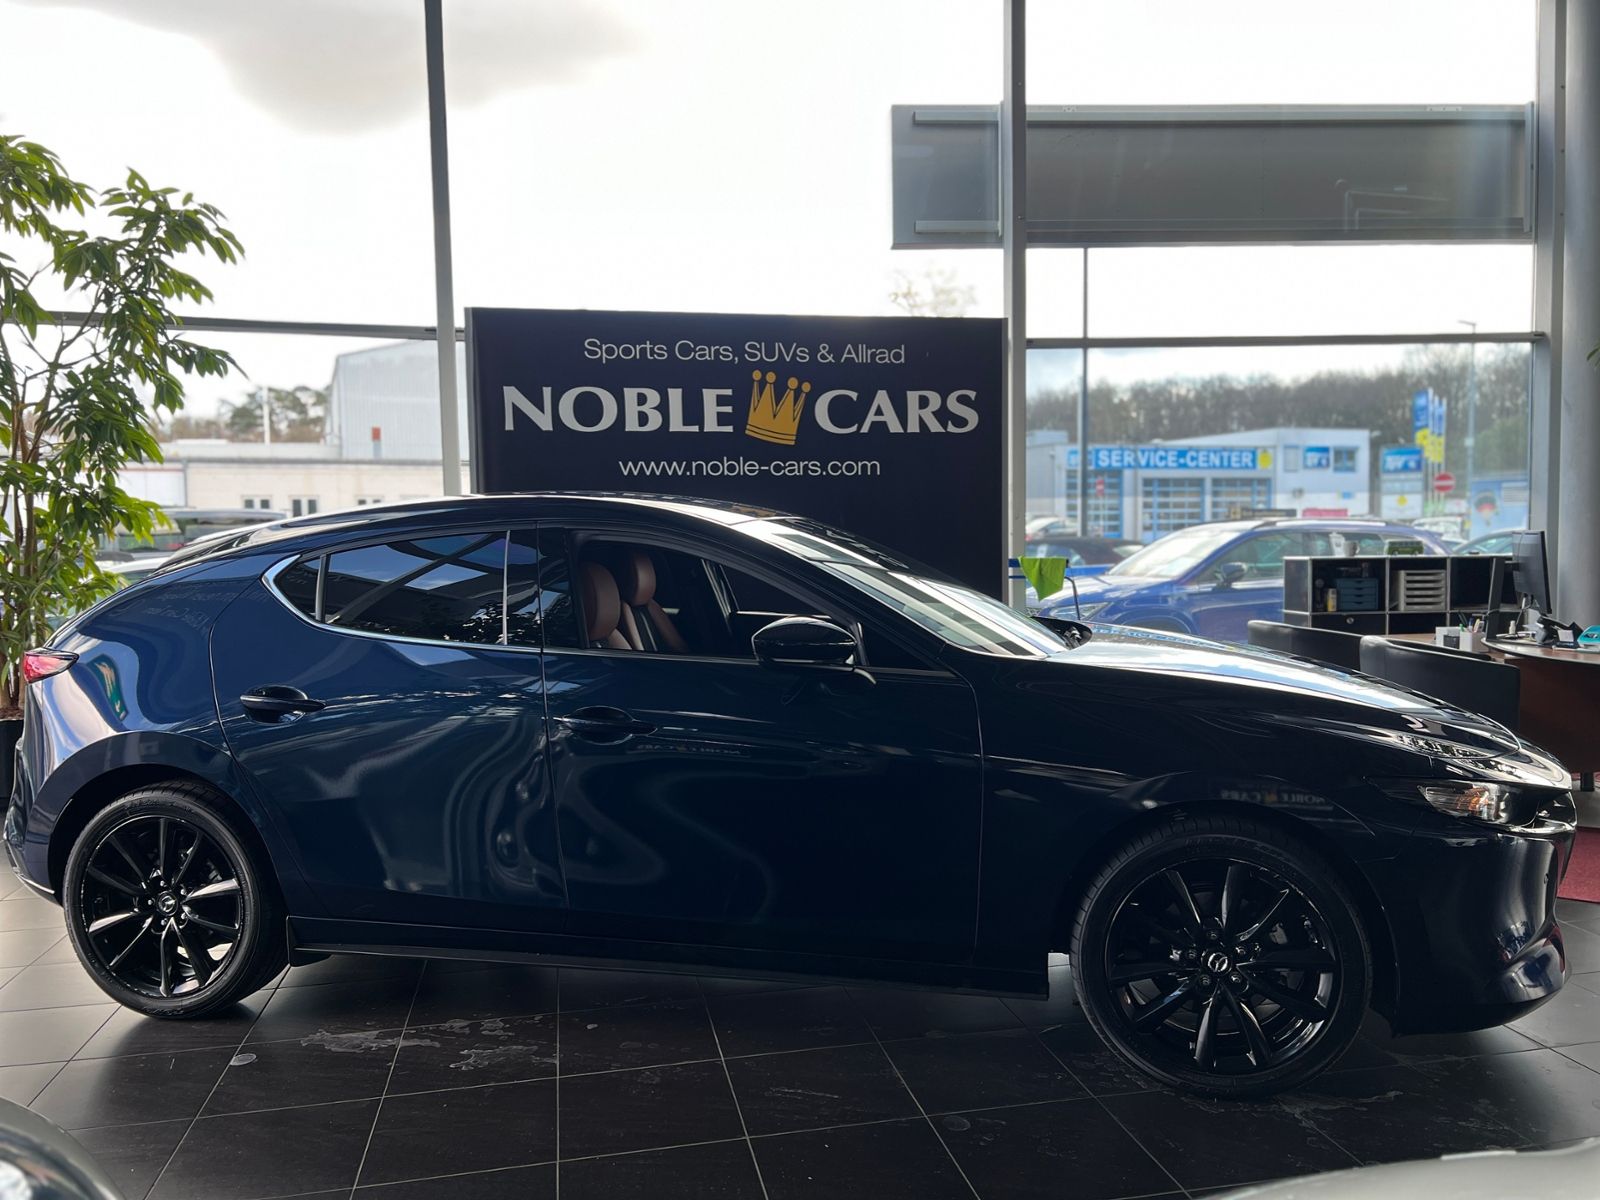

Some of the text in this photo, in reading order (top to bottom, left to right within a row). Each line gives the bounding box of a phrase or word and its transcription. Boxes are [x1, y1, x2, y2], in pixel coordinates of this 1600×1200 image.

[584, 338, 905, 364] Sports Cars, SUVs & Allrad
[502, 385, 980, 434] NOBLE CARS
[618, 456, 881, 477] www.noble-cars.com
[1099, 449, 1253, 468] SERVICE-CENTER
